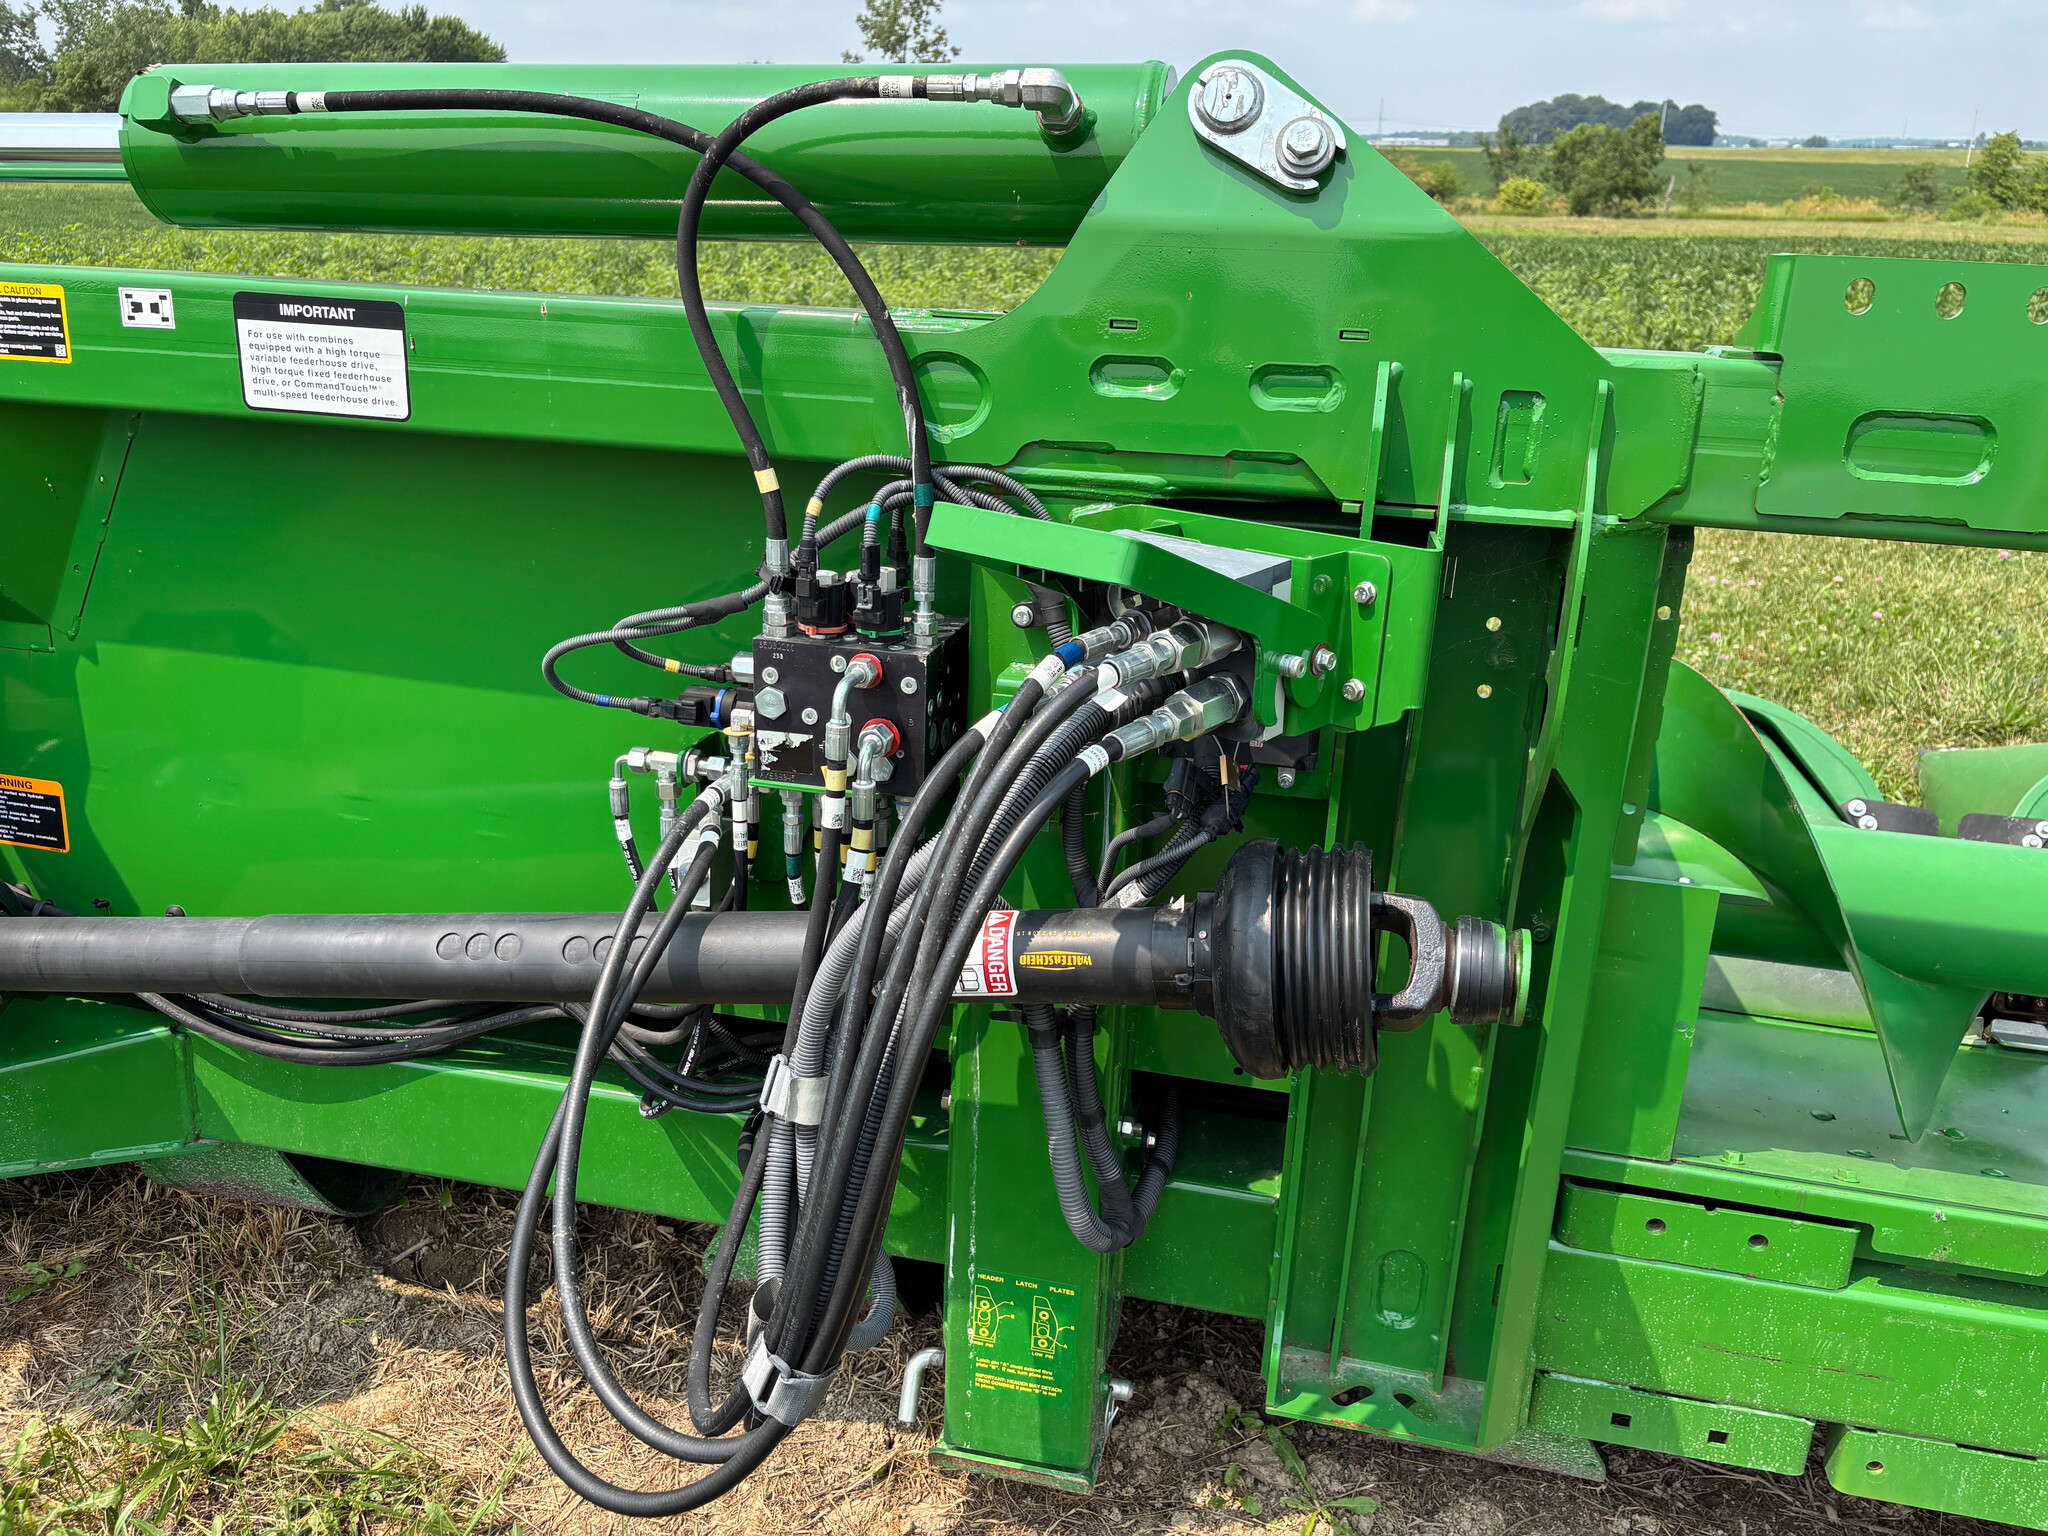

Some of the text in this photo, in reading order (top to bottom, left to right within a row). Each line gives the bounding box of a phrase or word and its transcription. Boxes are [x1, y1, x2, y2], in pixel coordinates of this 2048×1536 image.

[4, 286, 42, 295] CAUTION
[278, 303, 356, 320] IMPORTANT
[248, 330, 354, 345] For use with combines
[249, 342, 292, 353] equipped
[294, 345, 314, 354] with
[326, 347, 346, 357] high
[350, 349, 380, 360] torque
[250, 354, 378, 371] variable feederhouse drive,
[251, 365, 392, 383] high torque fixed feederhouse
[252, 377, 279, 387] drive,
[254, 389, 399, 407] multi-speed feederhouse drive.
[987, 926, 1008, 993] DANGER
[1020, 955, 1092, 966] WALTERSCHEID
[978, 1273, 1075, 1296] HEADER LATCH PLATES
